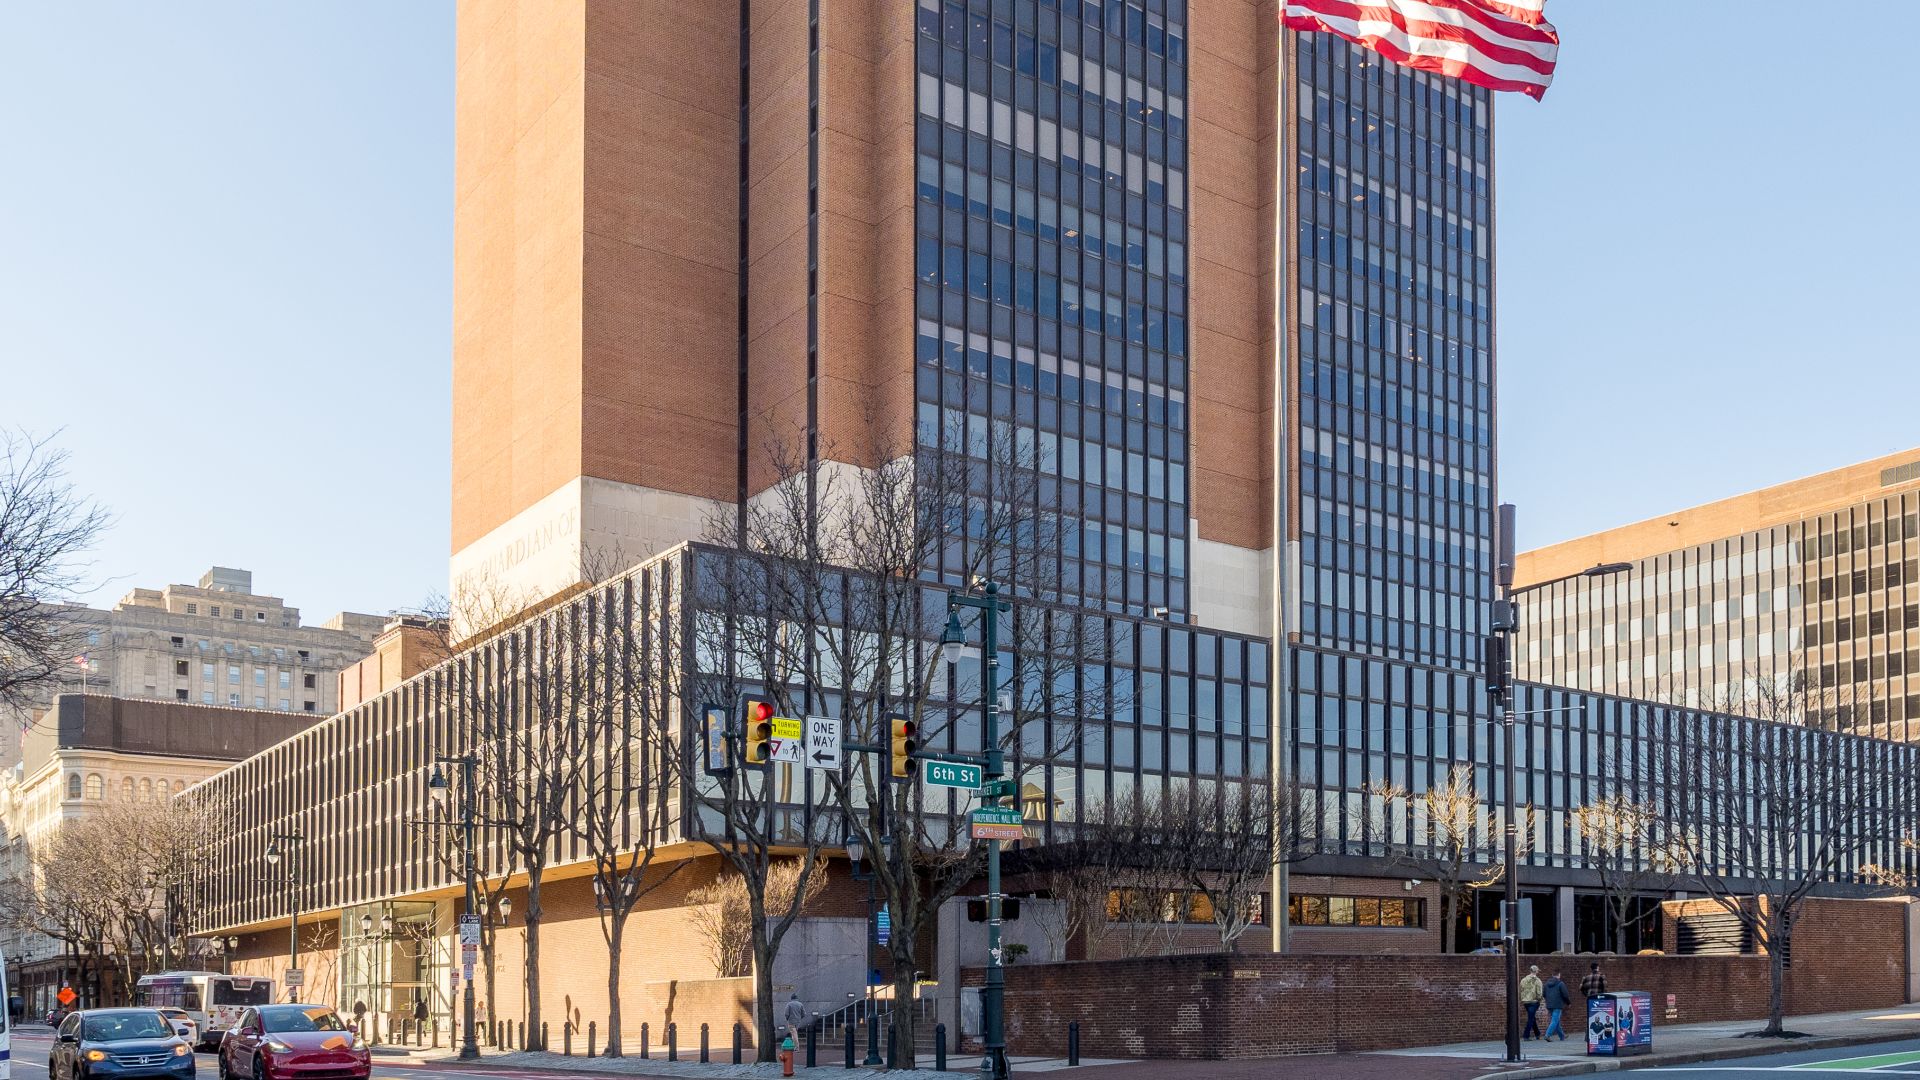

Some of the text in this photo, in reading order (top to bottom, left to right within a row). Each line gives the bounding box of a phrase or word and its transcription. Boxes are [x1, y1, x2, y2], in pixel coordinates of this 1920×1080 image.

[480, 520, 553, 580] GUARDIAN
[558, 506, 577, 537] OF
[778, 720, 800, 730] TURNING
[813, 722, 835, 734] ONE
[778, 729, 800, 737] VEHICLES
[813, 735, 835, 748] WAY
[933, 766, 955, 781] 6th
[960, 769, 975, 783] St
[976, 827, 994, 837] 6TH
